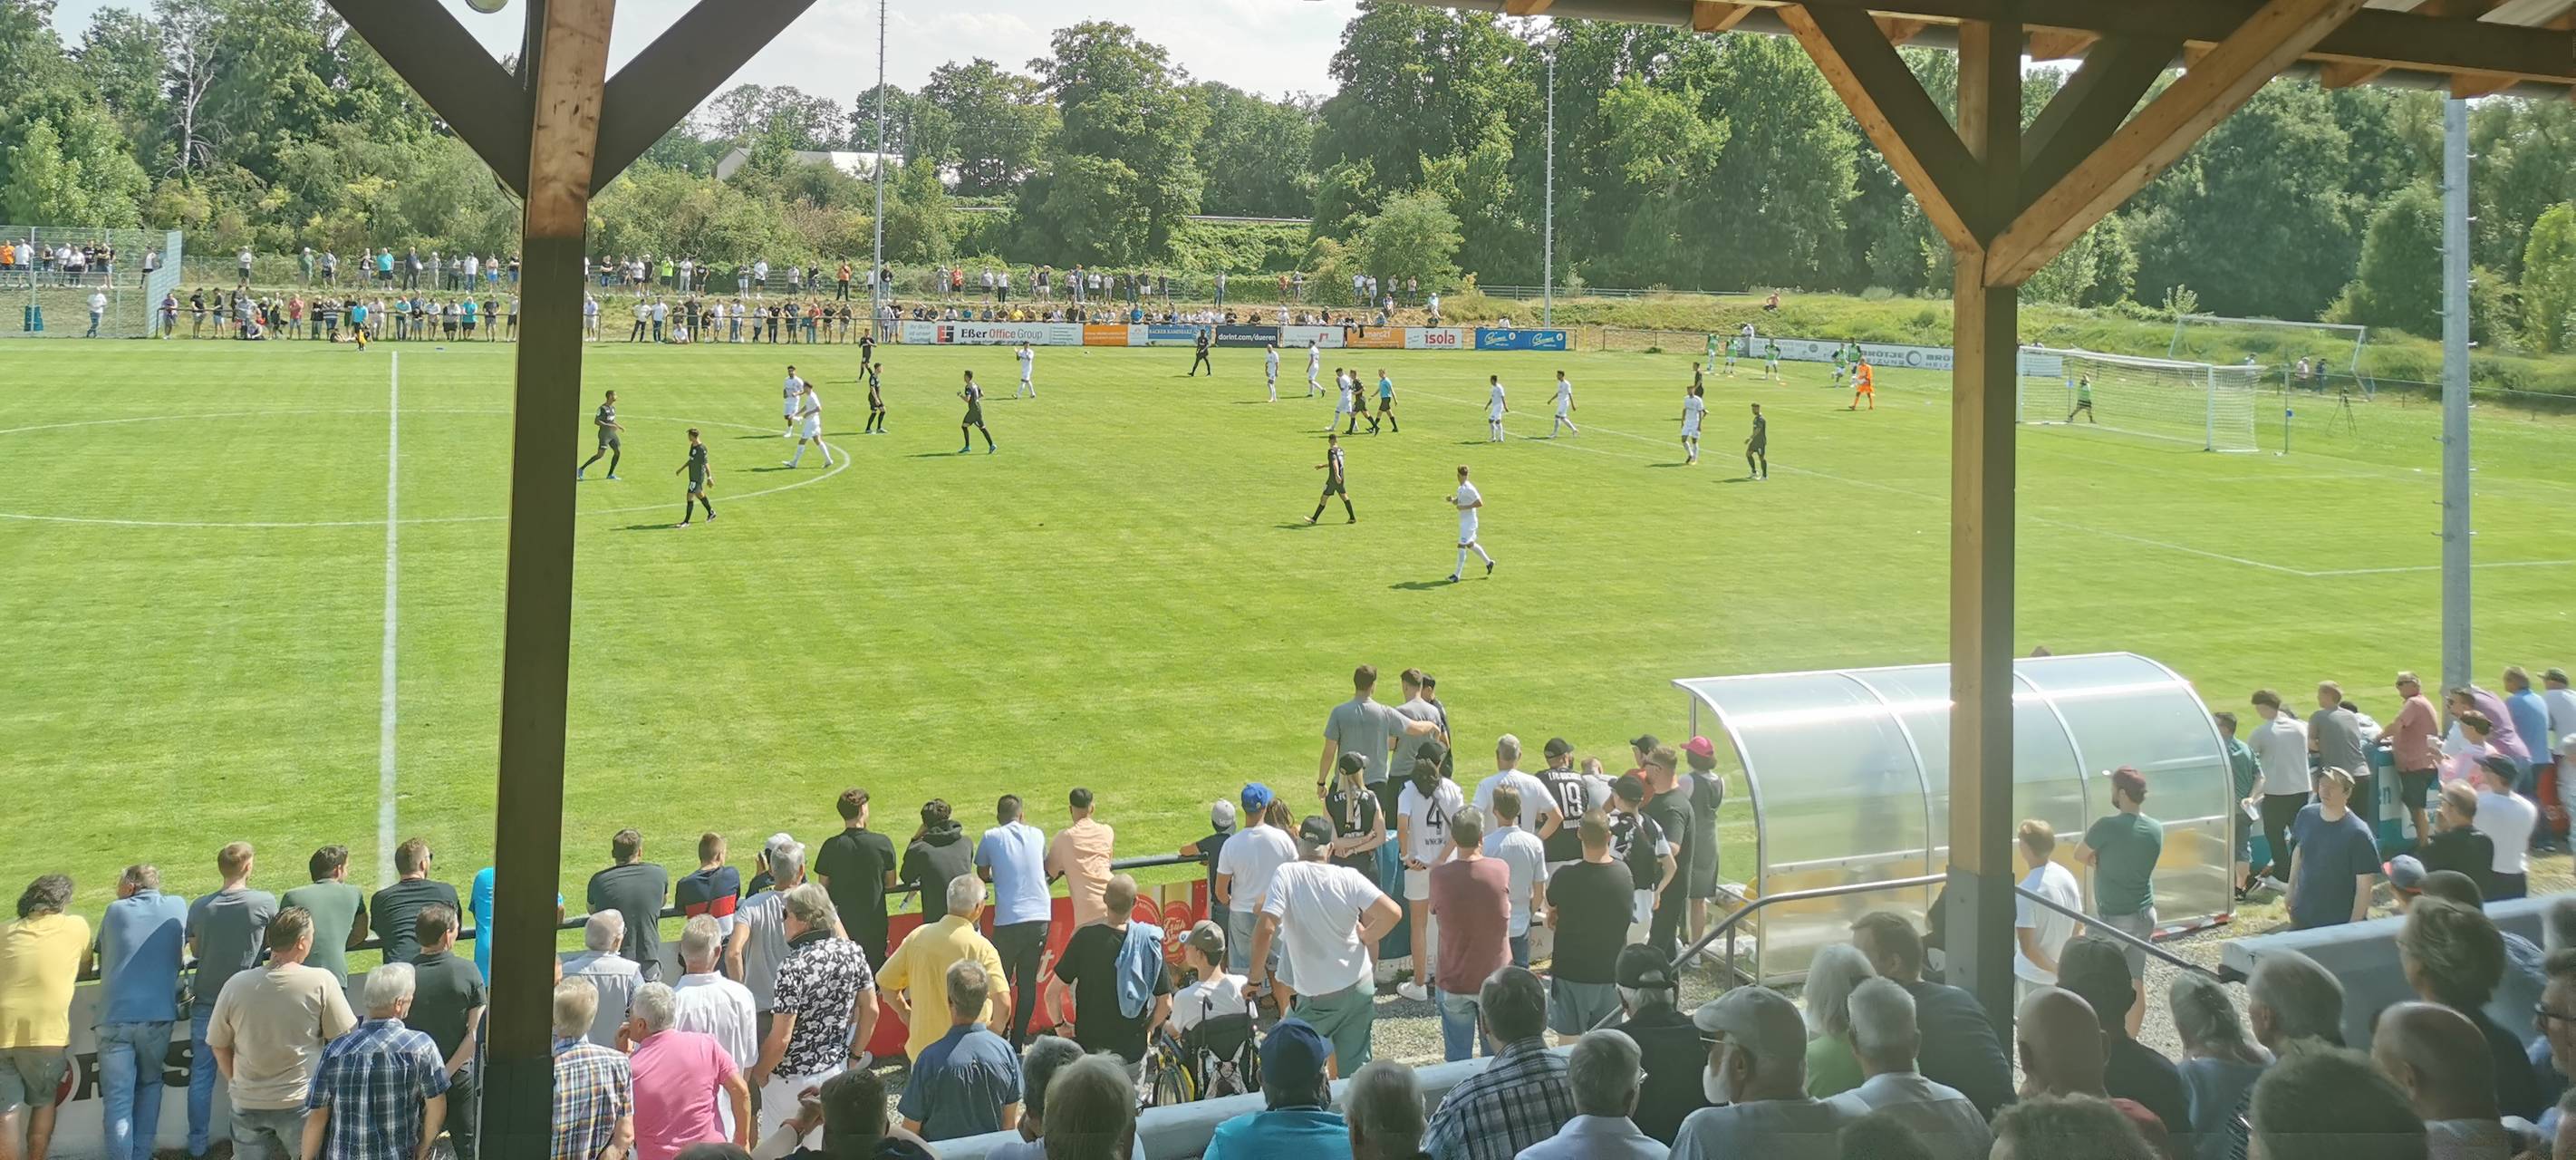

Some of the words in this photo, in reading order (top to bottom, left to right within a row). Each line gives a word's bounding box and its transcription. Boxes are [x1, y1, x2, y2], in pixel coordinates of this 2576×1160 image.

[989, 328, 1016, 339] Office
[1018, 328, 1043, 341] Group
[1218, 333, 1276, 342] dorint.com/dueren
[1424, 330, 1455, 343] isola
[1866, 357, 1905, 365] EIZUNG
[1558, 782, 1583, 817] 19
[1426, 799, 1442, 835] 4
